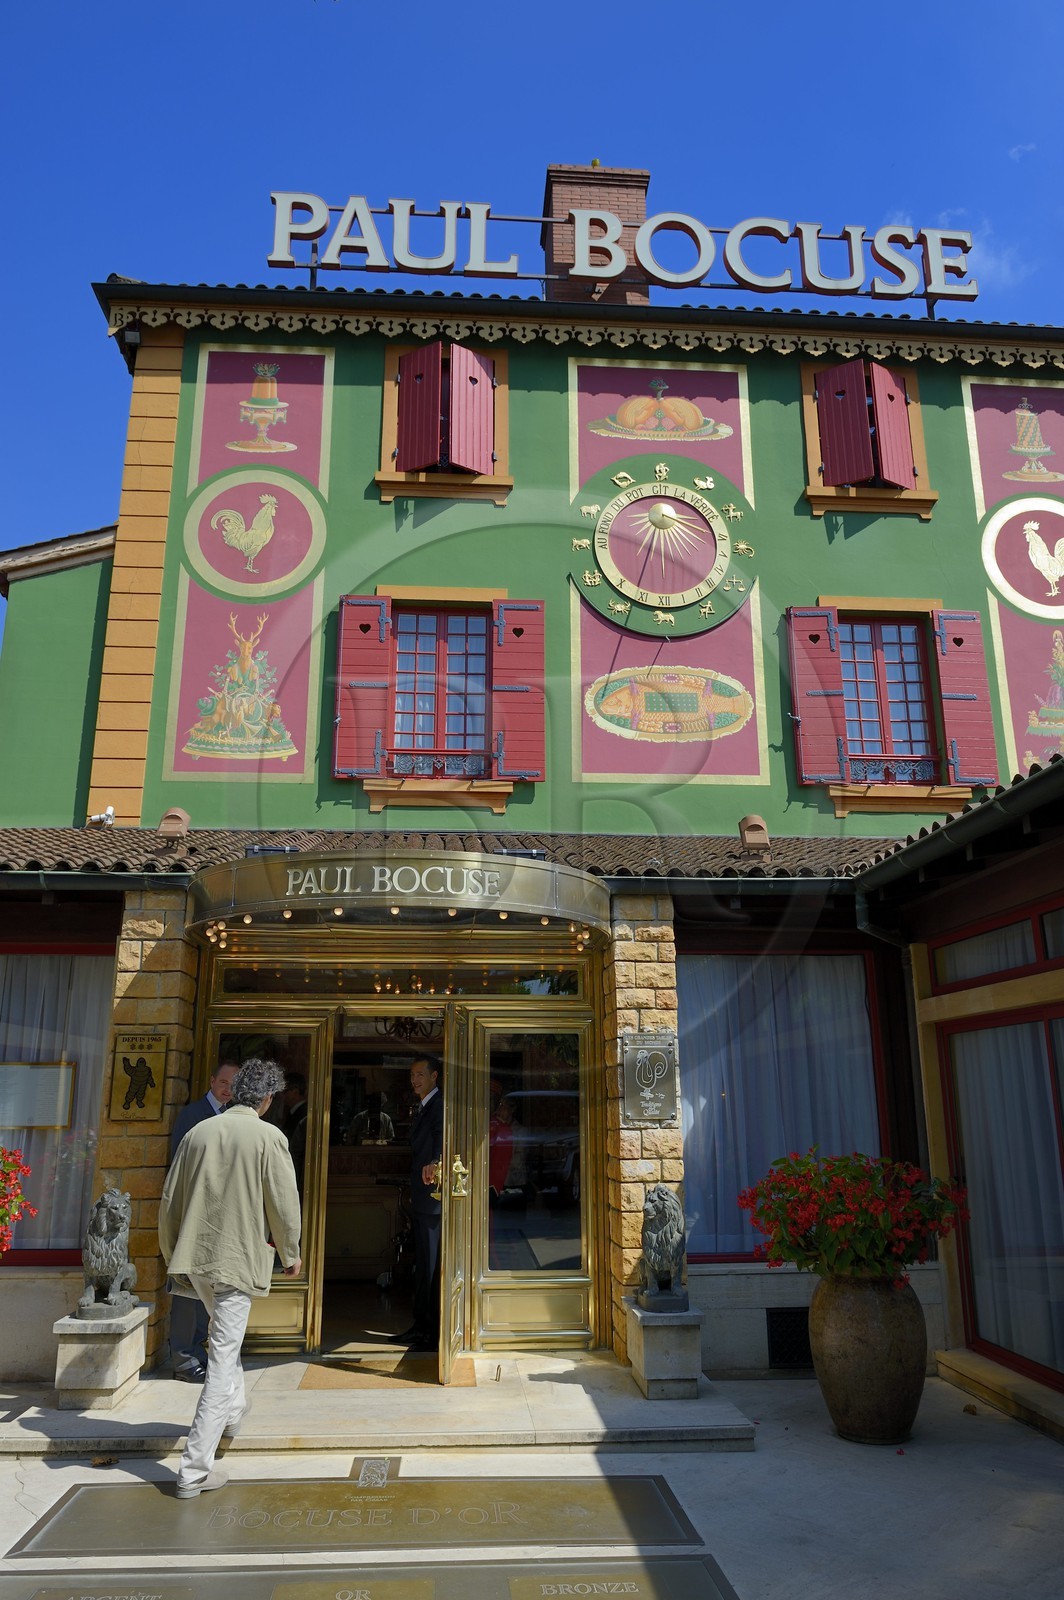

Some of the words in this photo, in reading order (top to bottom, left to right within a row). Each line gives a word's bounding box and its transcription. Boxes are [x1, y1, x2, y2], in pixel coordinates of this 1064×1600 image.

[267, 191, 519, 278] PAUL
[568, 208, 979, 302] BOCUSE
[625, 487, 644, 501] POT
[674, 487, 686, 500] LA
[611, 500, 625, 512] DU
[599, 511, 614, 535] FOND
[598, 537, 608, 550] AU
[616, 578, 626, 589] X
[638, 591, 649, 602] XI
[658, 595, 671, 606] XII
[695, 587, 703, 598] II
[286, 866, 361, 896] PAUL
[372, 866, 501, 898] BOCUSE
[200, 1505, 394, 1529] BOCUSE
[408, 1501, 529, 1525] D'OR
[335, 1589, 372, 1600] OR
[539, 1582, 640, 1595] BRONZE
